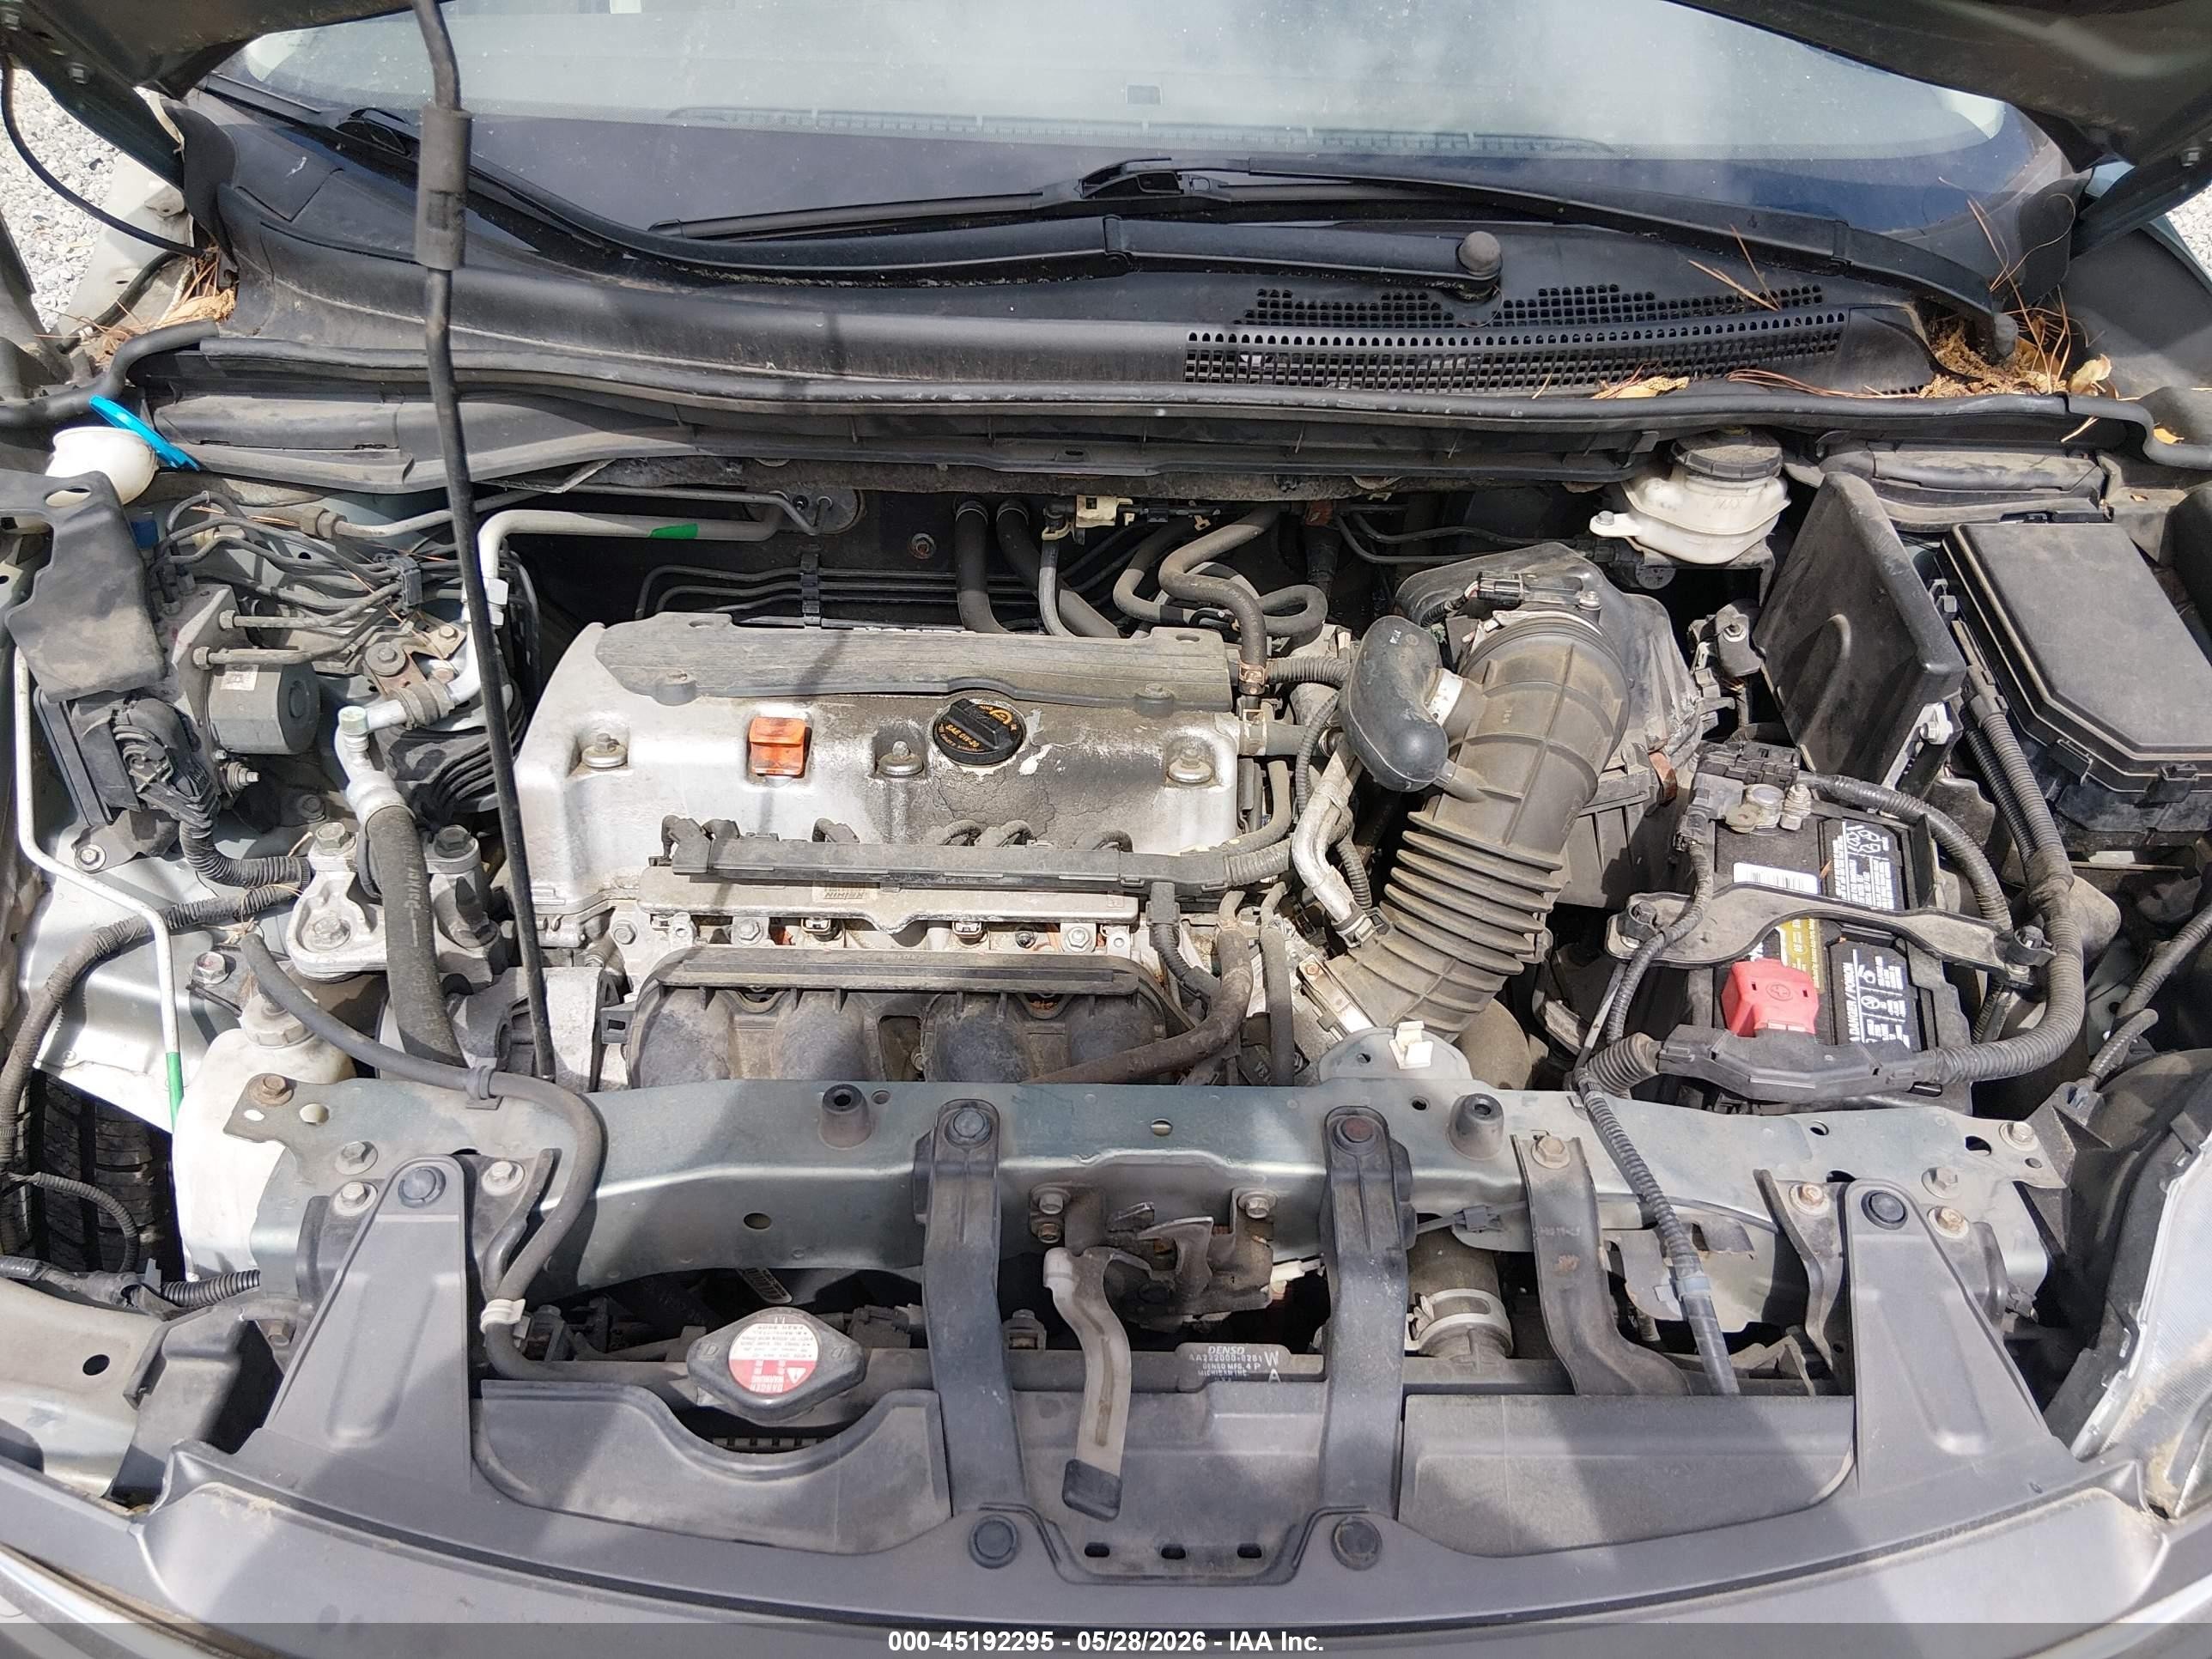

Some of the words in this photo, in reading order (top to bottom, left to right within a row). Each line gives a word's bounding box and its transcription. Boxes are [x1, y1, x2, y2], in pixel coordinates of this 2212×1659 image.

[945, 724, 959, 736] SAE
[1842, 962, 1856, 992] POISON
[1846, 1000, 1861, 1036] DANGER
[1208, 1346, 1245, 1354] DENSO
[1263, 1350, 1279, 1367] W
[1267, 1368, 1282, 1385] A
[749, 1382, 784, 1393] DANGER
